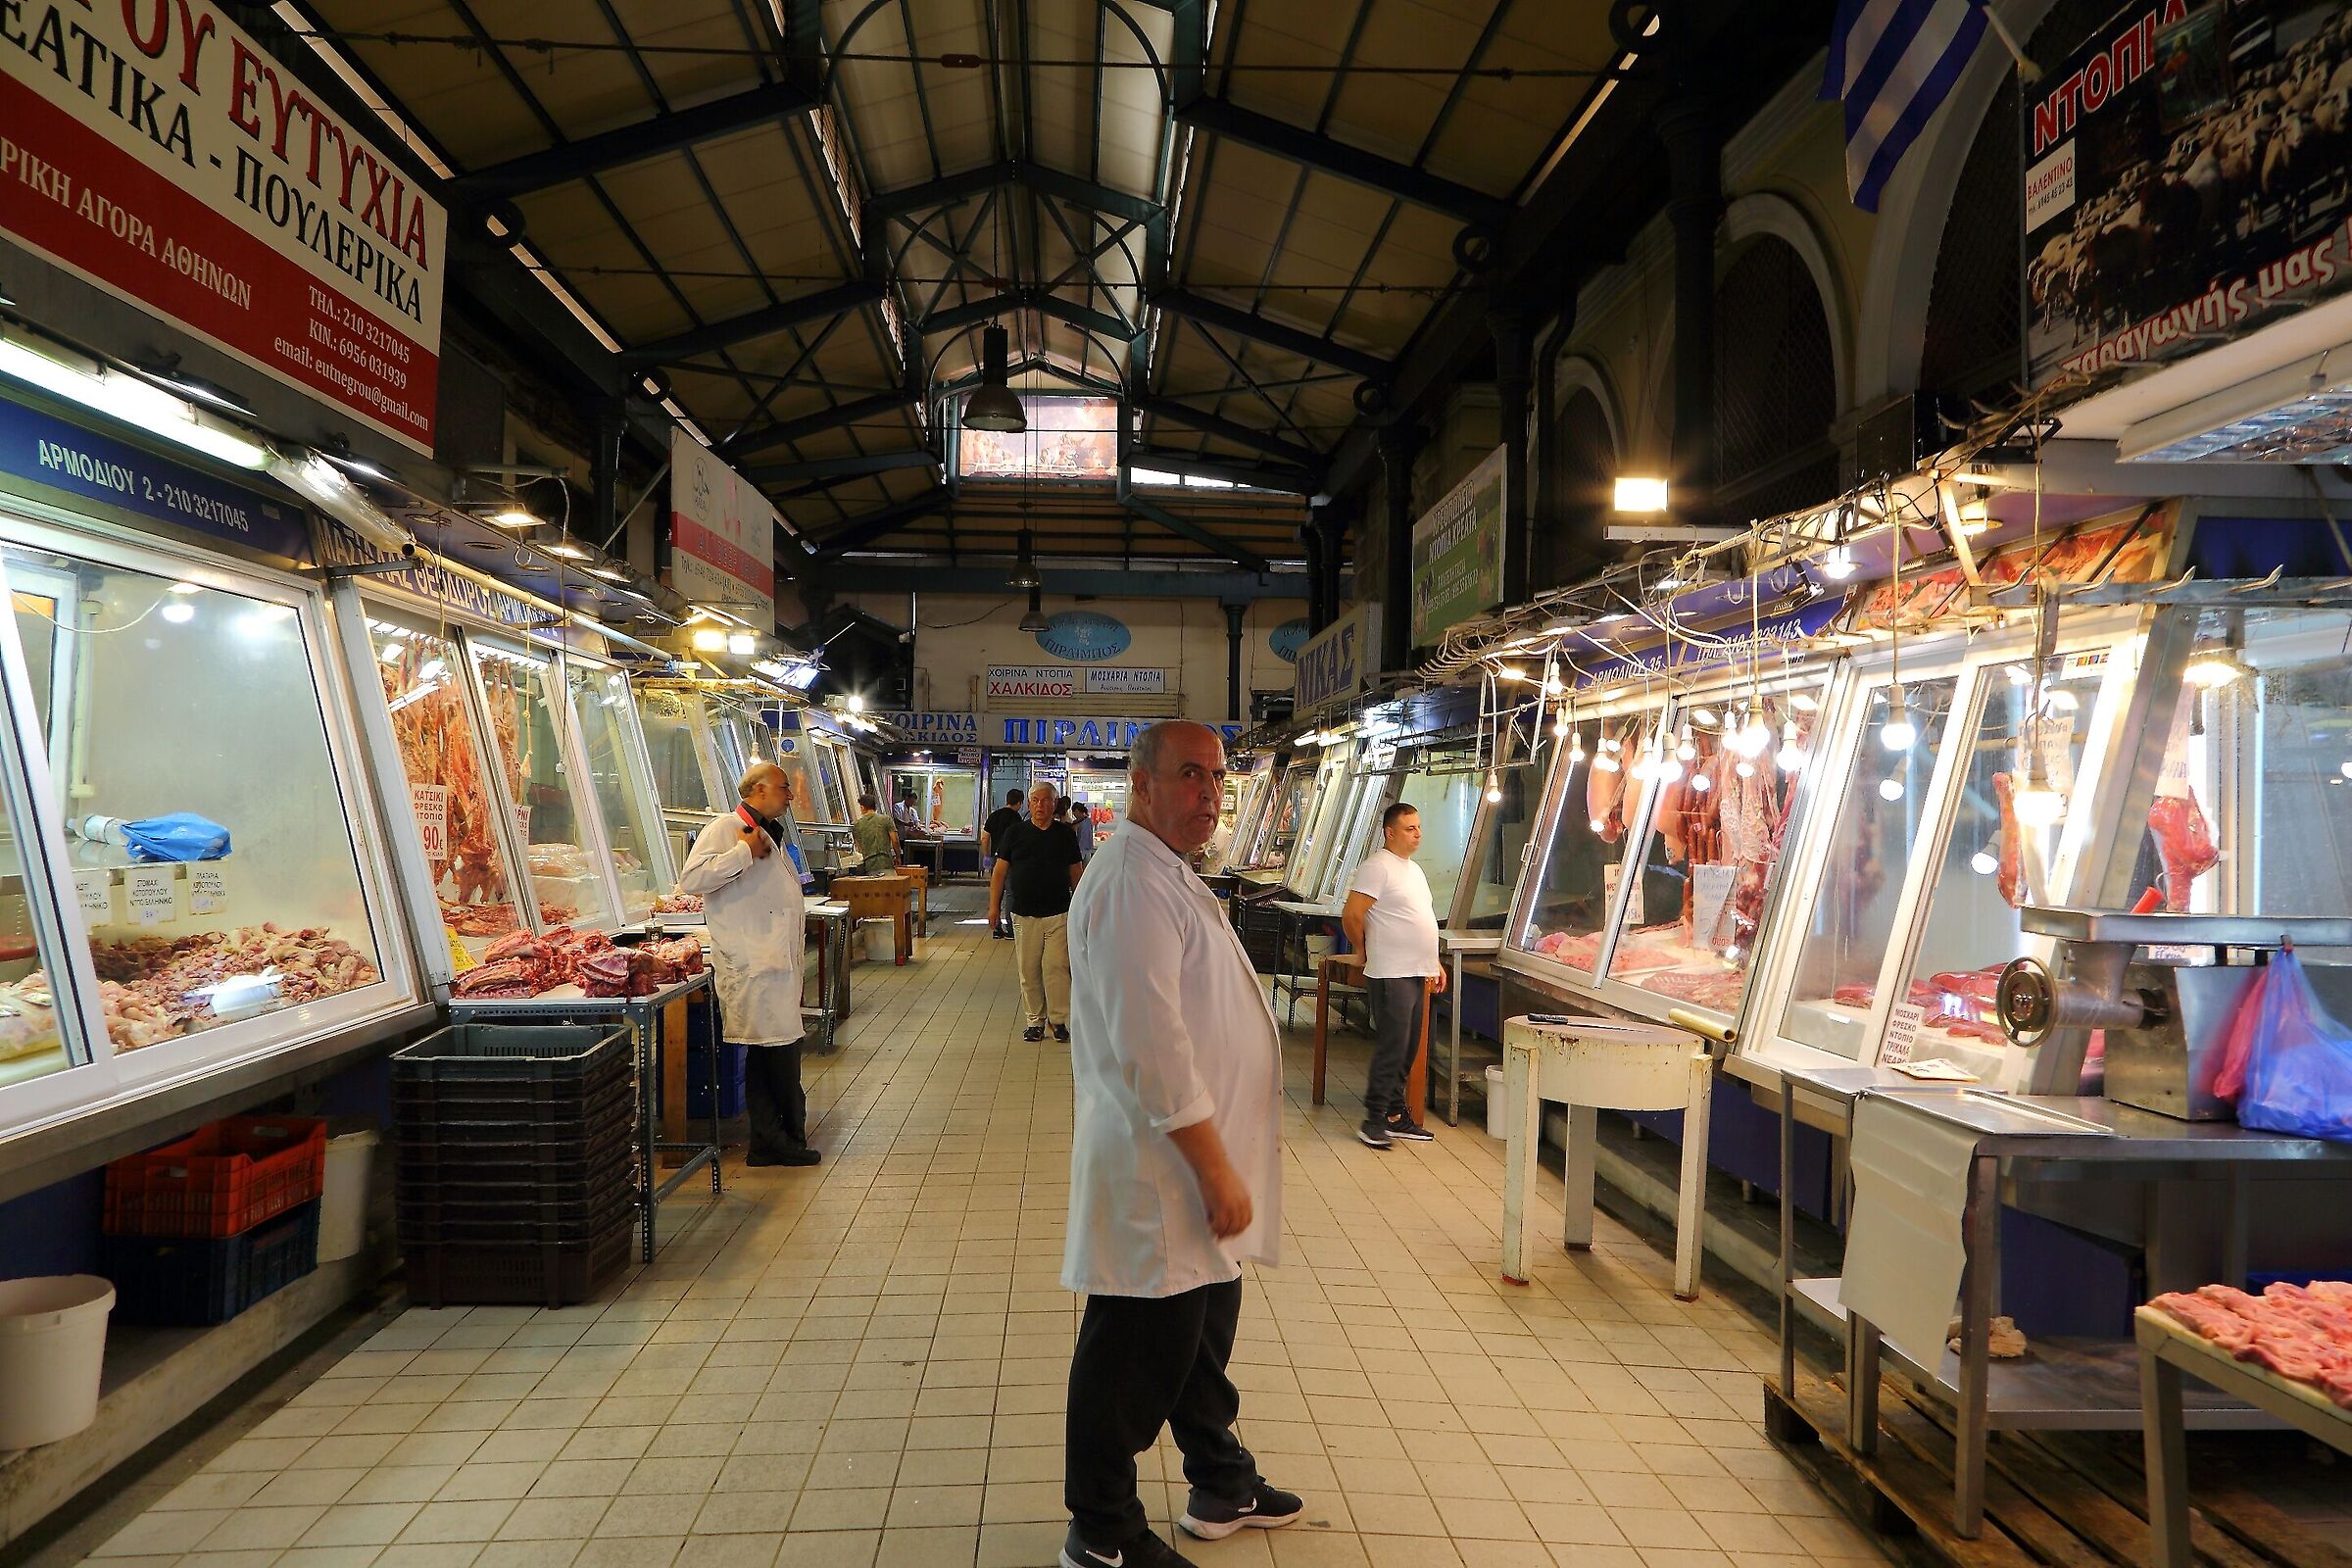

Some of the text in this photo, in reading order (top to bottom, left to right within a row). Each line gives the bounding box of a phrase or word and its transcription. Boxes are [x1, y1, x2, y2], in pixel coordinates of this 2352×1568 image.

[227, 36, 428, 272] ΕΥΤΥΧΙΑ
[76, 187, 156, 258] ΑΓΟΡΑ
[161, 237, 252, 311] ΑΘΗΝΩΝ
[233, 145, 422, 324] ΠΟΥΛΕΡΙΚΑ
[2258, 236, 2337, 299] μας
[339, 337, 368, 368] 6956
[368, 354, 407, 390] 031939
[343, 307, 365, 336] 210
[366, 321, 410, 365] 3217045
[274, 336, 428, 431] email: eutnegrou@gmail.com
[39, 439, 134, 494] ΑΡΜΟΔΙΟΥ
[142, 476, 154, 501] 2
[165, 483, 192, 514] 210
[193, 494, 250, 532] 3217045
[1428, 507, 1478, 565] ΝΤΟΠΙΑ ΚΡΕΑΤΑ
[988, 668, 1073, 678] ΧΟΙΡΙΝΑ ΝΤΟΠΙΑ
[990, 682, 1073, 696] ΧΑΛΚΙΔΟΣ
[1090, 670, 1160, 681] ΜΟΣΧΑΡΙΑ ΝΤΟΠΙΑ
[1297, 621, 1355, 711] ΝΙΚΑΣ
[415, 789, 444, 803] ΚΑΤΣΙΚΙ
[415, 803, 444, 811] ΦΡΕΣΚΟ
[1886, 1041, 1910, 1055] ΤΡΙΚΑΛΑ
[1888, 1031, 1914, 1044] ΝΤΟΠΙΟ
[1891, 1019, 1917, 1032] ΦΡΕΣΚΟ
